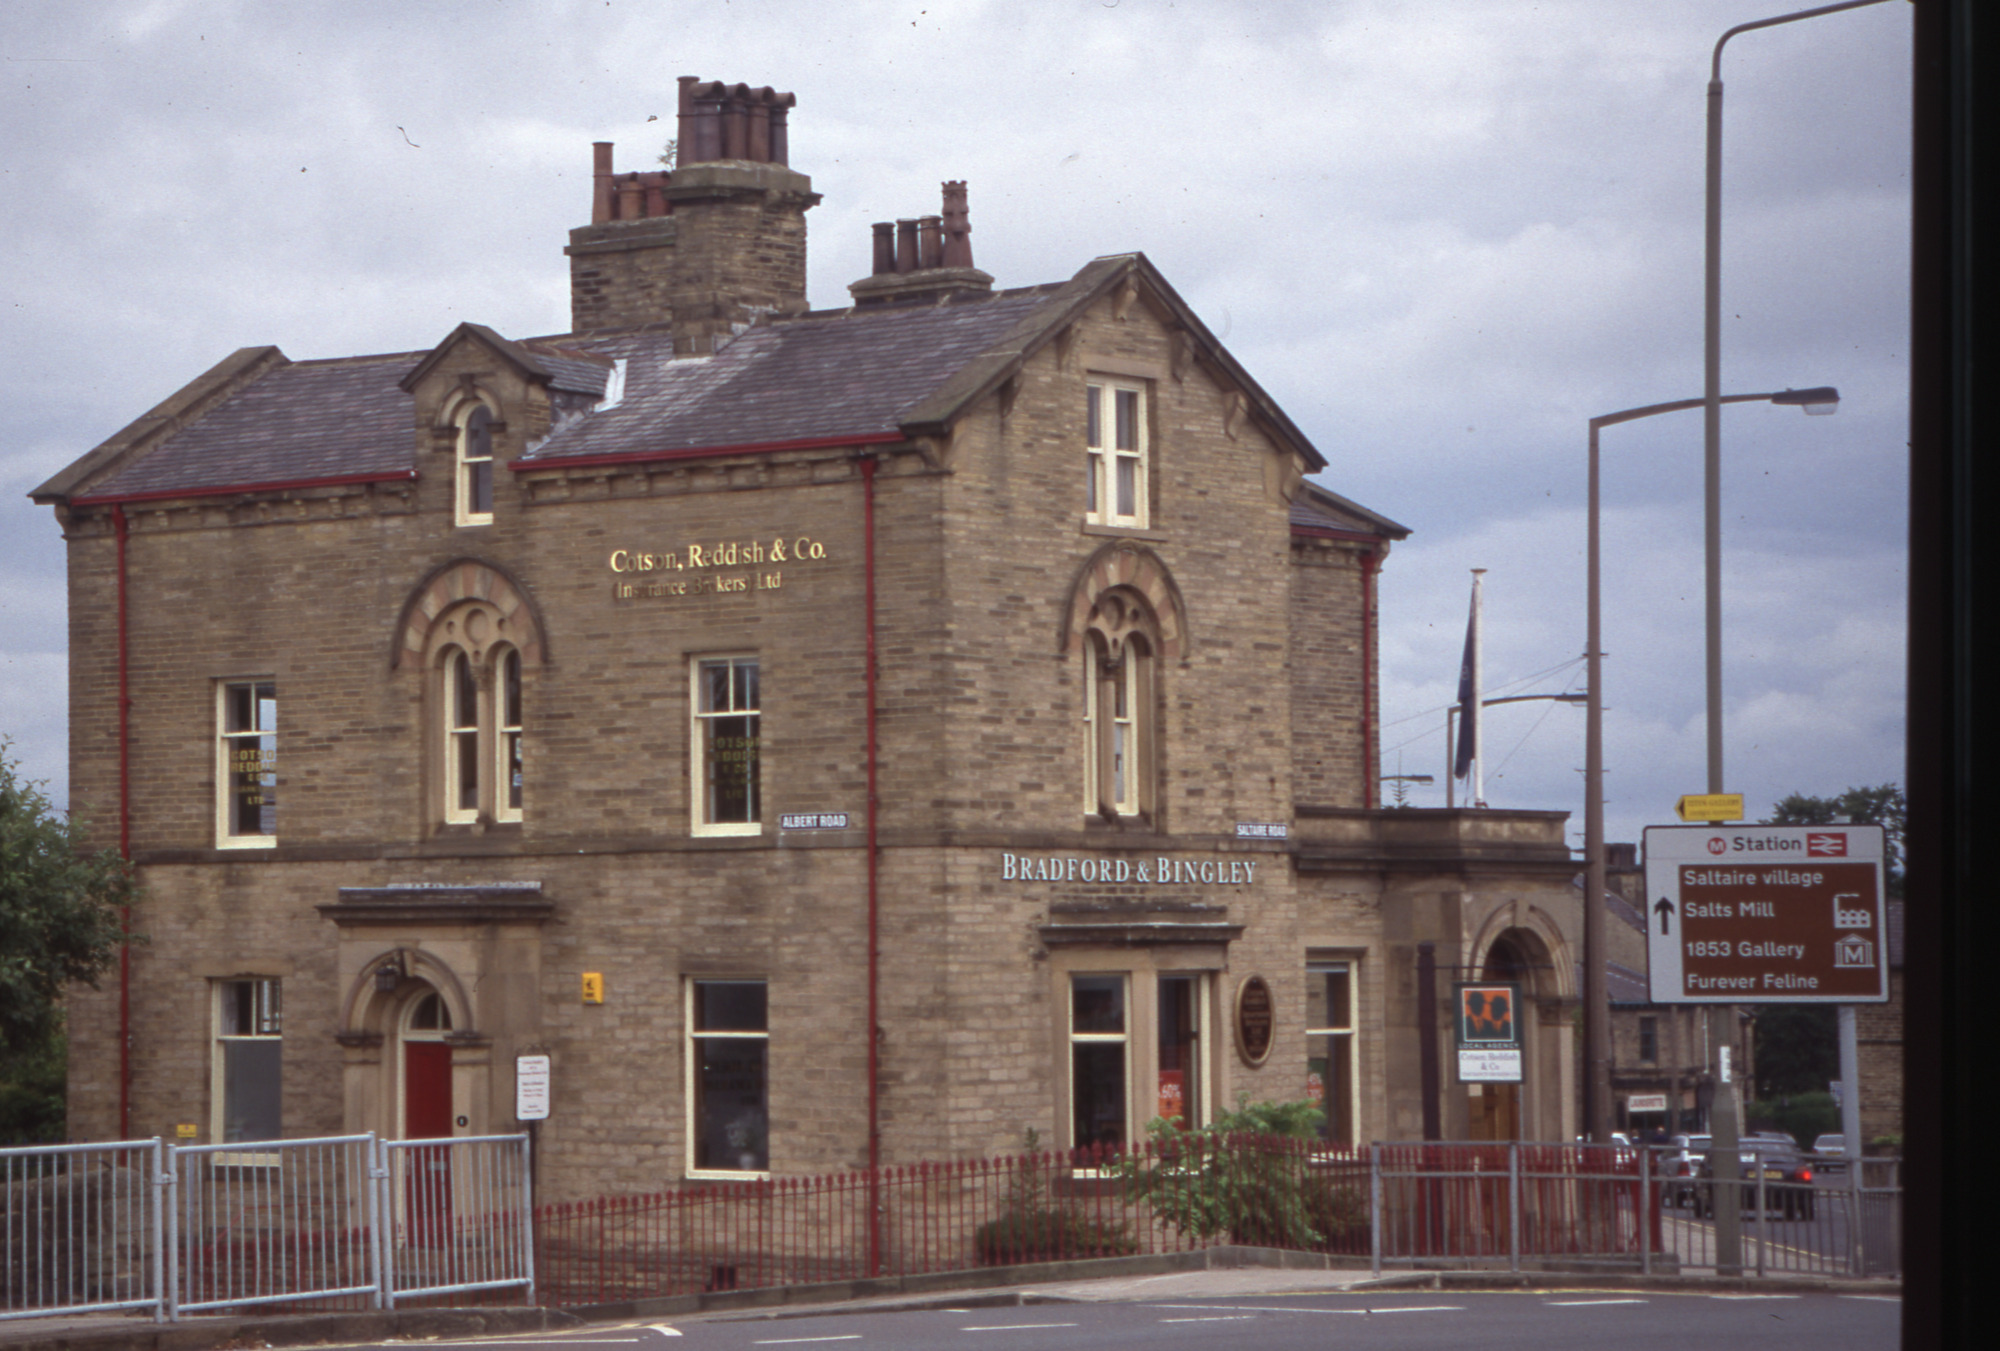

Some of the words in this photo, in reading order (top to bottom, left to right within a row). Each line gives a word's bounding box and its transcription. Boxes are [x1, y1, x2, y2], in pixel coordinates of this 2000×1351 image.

[610, 550, 684, 572] Cotson,
[688, 541, 764, 568] Reddish
[769, 538, 787, 562] &
[795, 537, 828, 560] Co.
[756, 571, 782, 590] Ltd
[782, 815, 818, 828] ALBERT
[820, 814, 847, 827] ROAD
[1237, 824, 1267, 836] SALTAIRE
[1268, 825, 1287, 837] ROAD
[1732, 836, 1802, 851] Station
[1002, 853, 1130, 882] BRADFORD
[1136, 860, 1150, 882] &
[1156, 857, 1256, 884] BINGLEY
[1684, 870, 1757, 885] Saltaire
[1762, 869, 1824, 887] village
[1685, 902, 1733, 917] Salts
[1739, 901, 1775, 917] Mill
[1687, 941, 1732, 957] 1853
[1738, 941, 1805, 960] Gallery
[1687, 973, 1756, 989] Furever
[1763, 973, 1819, 989] Feline
